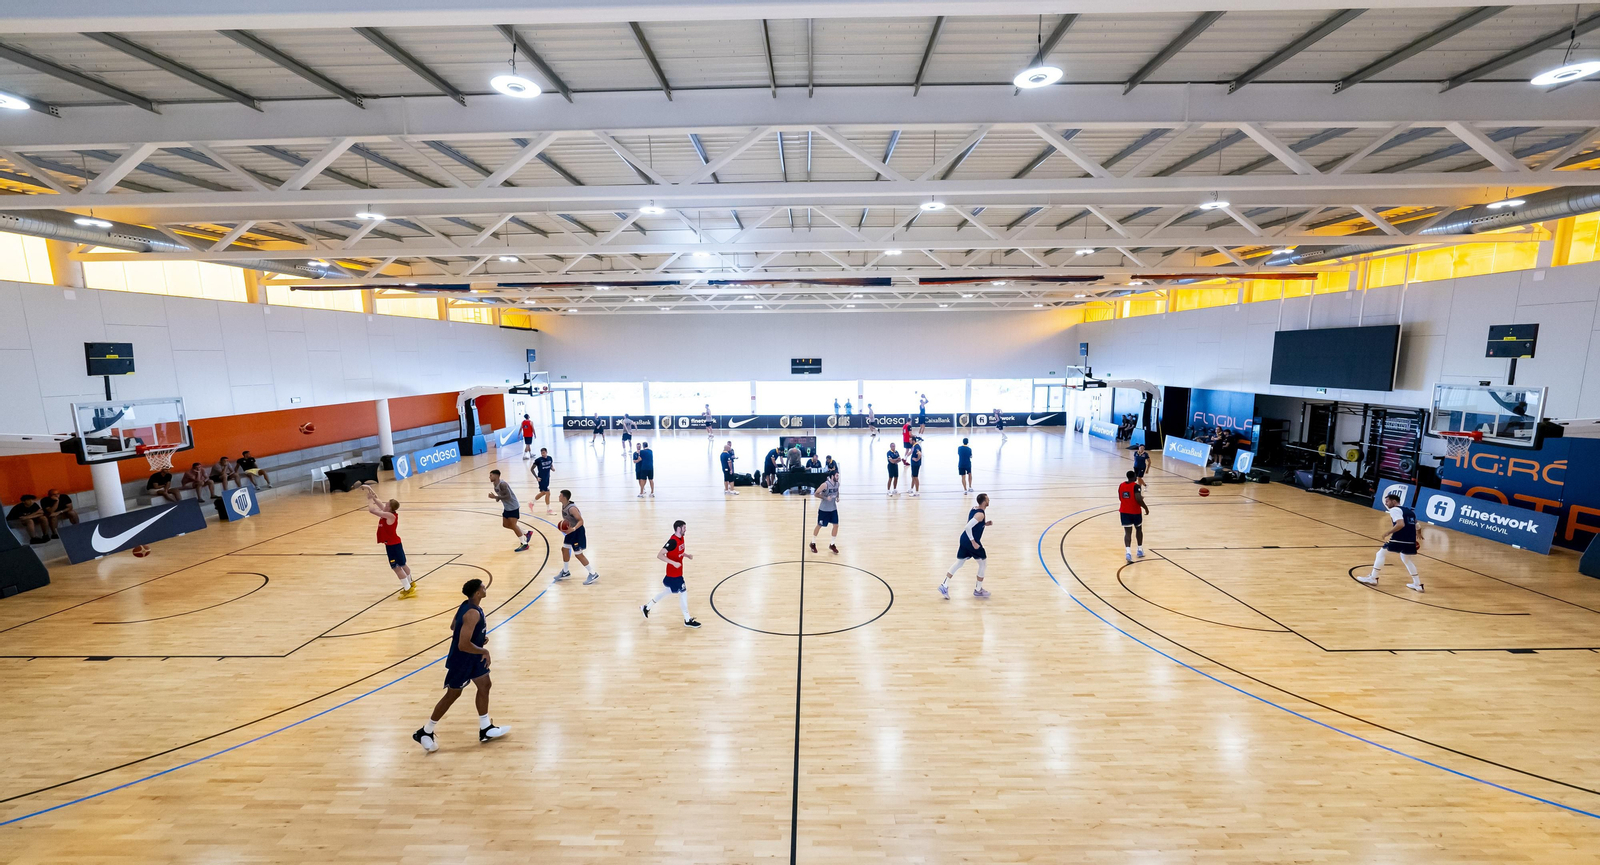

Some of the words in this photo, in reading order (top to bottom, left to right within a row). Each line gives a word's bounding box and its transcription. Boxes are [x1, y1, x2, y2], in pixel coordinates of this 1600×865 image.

[567, 418, 607, 427] endea
[420, 448, 458, 467] endesa
[1177, 444, 1203, 459] CaixaBank
[1458, 517, 1479, 528] FIBRA
[1485, 523, 1509, 535] MÓVIL
[1460, 504, 1540, 534] finetwork
